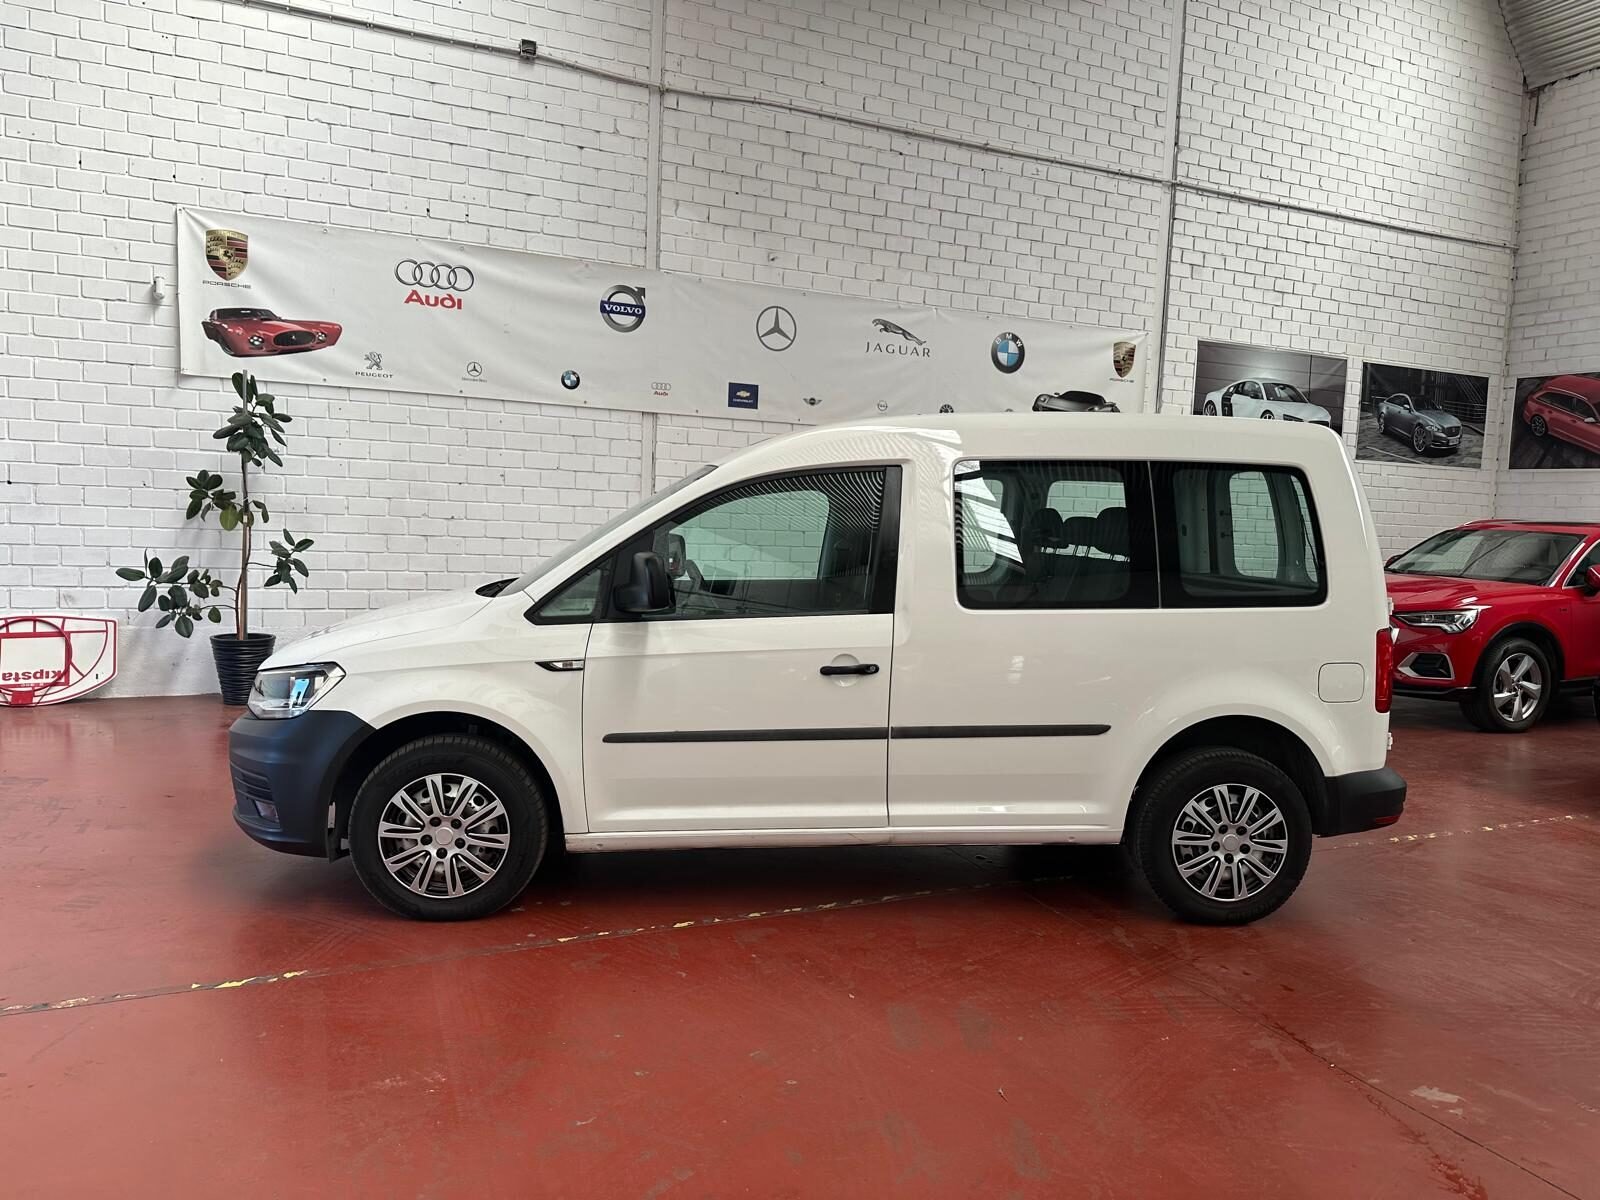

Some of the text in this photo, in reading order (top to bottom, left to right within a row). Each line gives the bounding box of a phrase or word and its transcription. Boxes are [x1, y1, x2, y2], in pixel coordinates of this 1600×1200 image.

[202, 280, 251, 289] PORSCHE
[404, 289, 462, 310] Audi
[604, 303, 642, 315] VOLVO
[865, 341, 931, 358] JAGUAR
[355, 371, 394, 379] PEUGEOT
